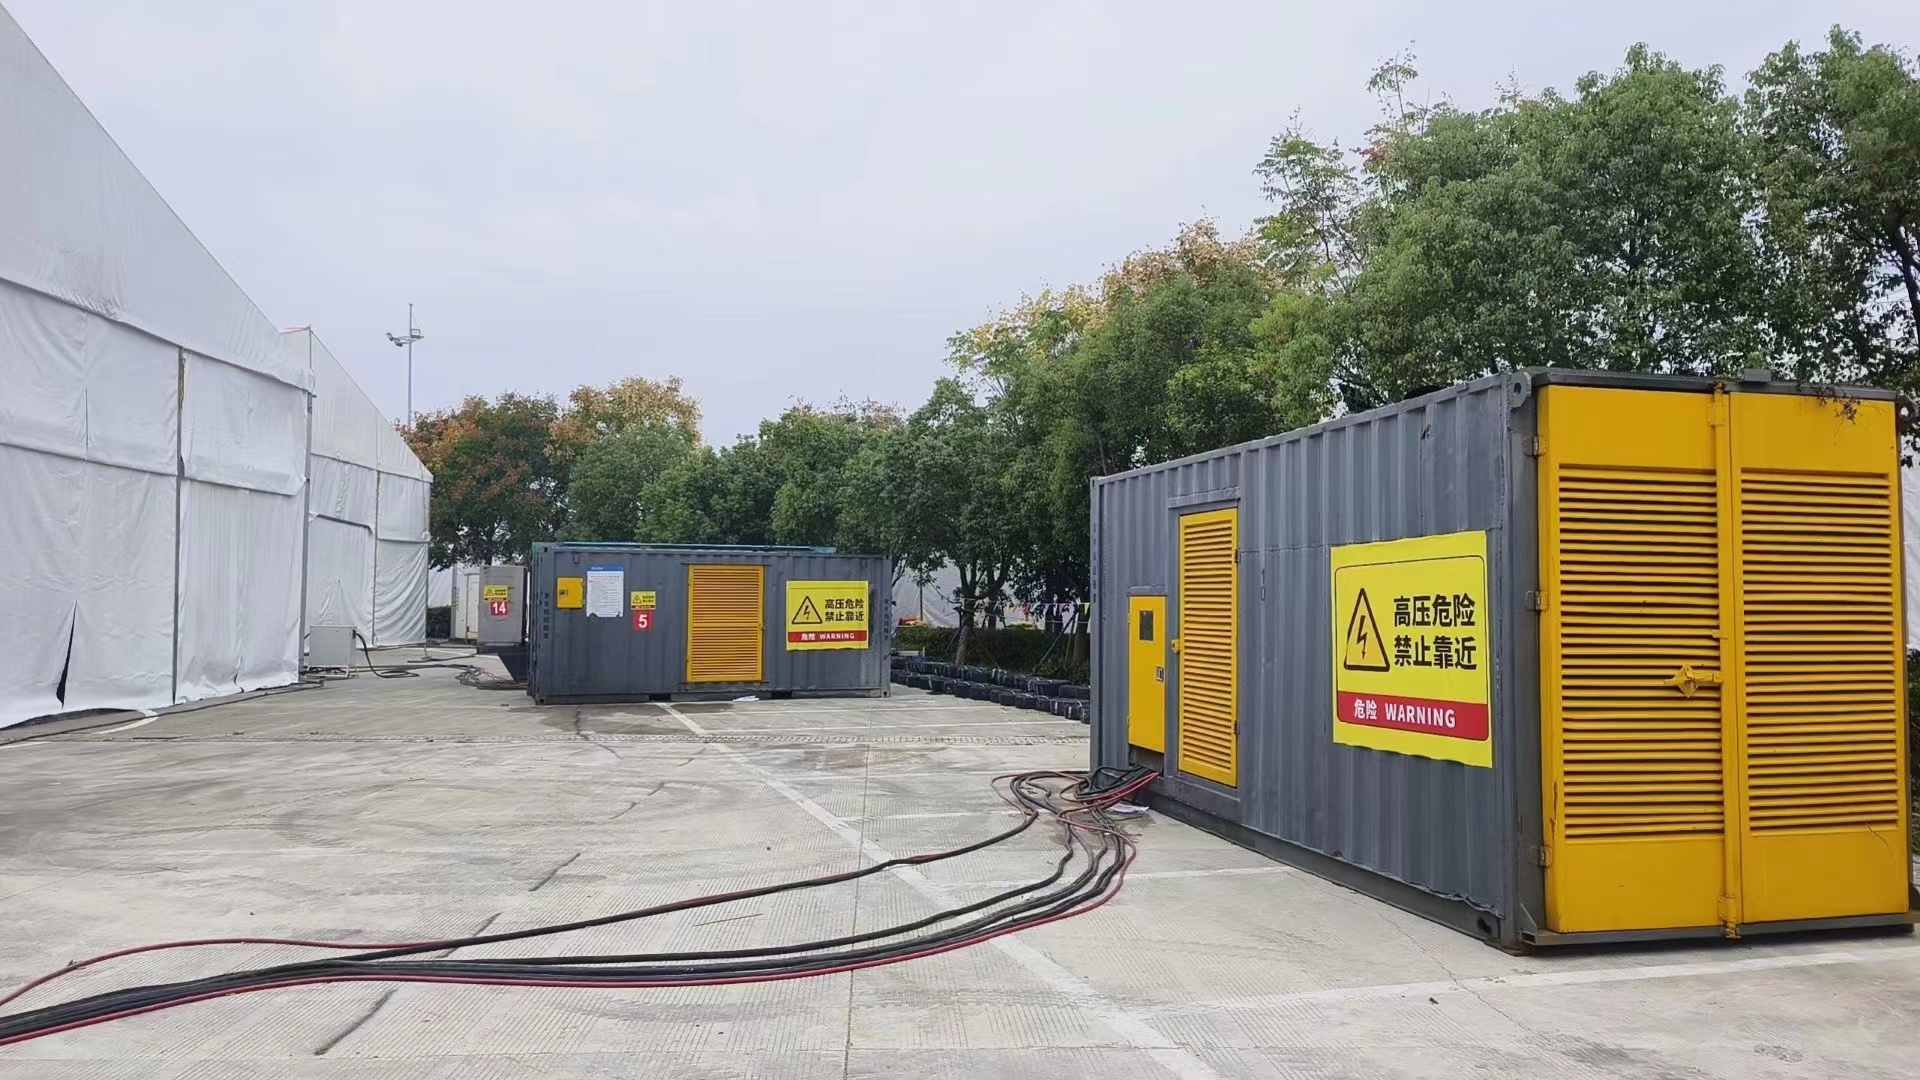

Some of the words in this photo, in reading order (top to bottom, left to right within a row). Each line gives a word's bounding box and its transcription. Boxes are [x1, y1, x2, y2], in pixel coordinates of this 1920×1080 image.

[492, 601, 506, 614] 14
[824, 598, 864, 609] 高压危险
[824, 611, 864, 622] 禁止靠近
[1393, 593, 1475, 628] 高压危险
[638, 614, 648, 628] 5
[819, 632, 855, 640] WARNING
[1394, 634, 1478, 671] 禁止靠近
[1353, 698, 1378, 720] 危险
[1385, 703, 1456, 728] WARNING
